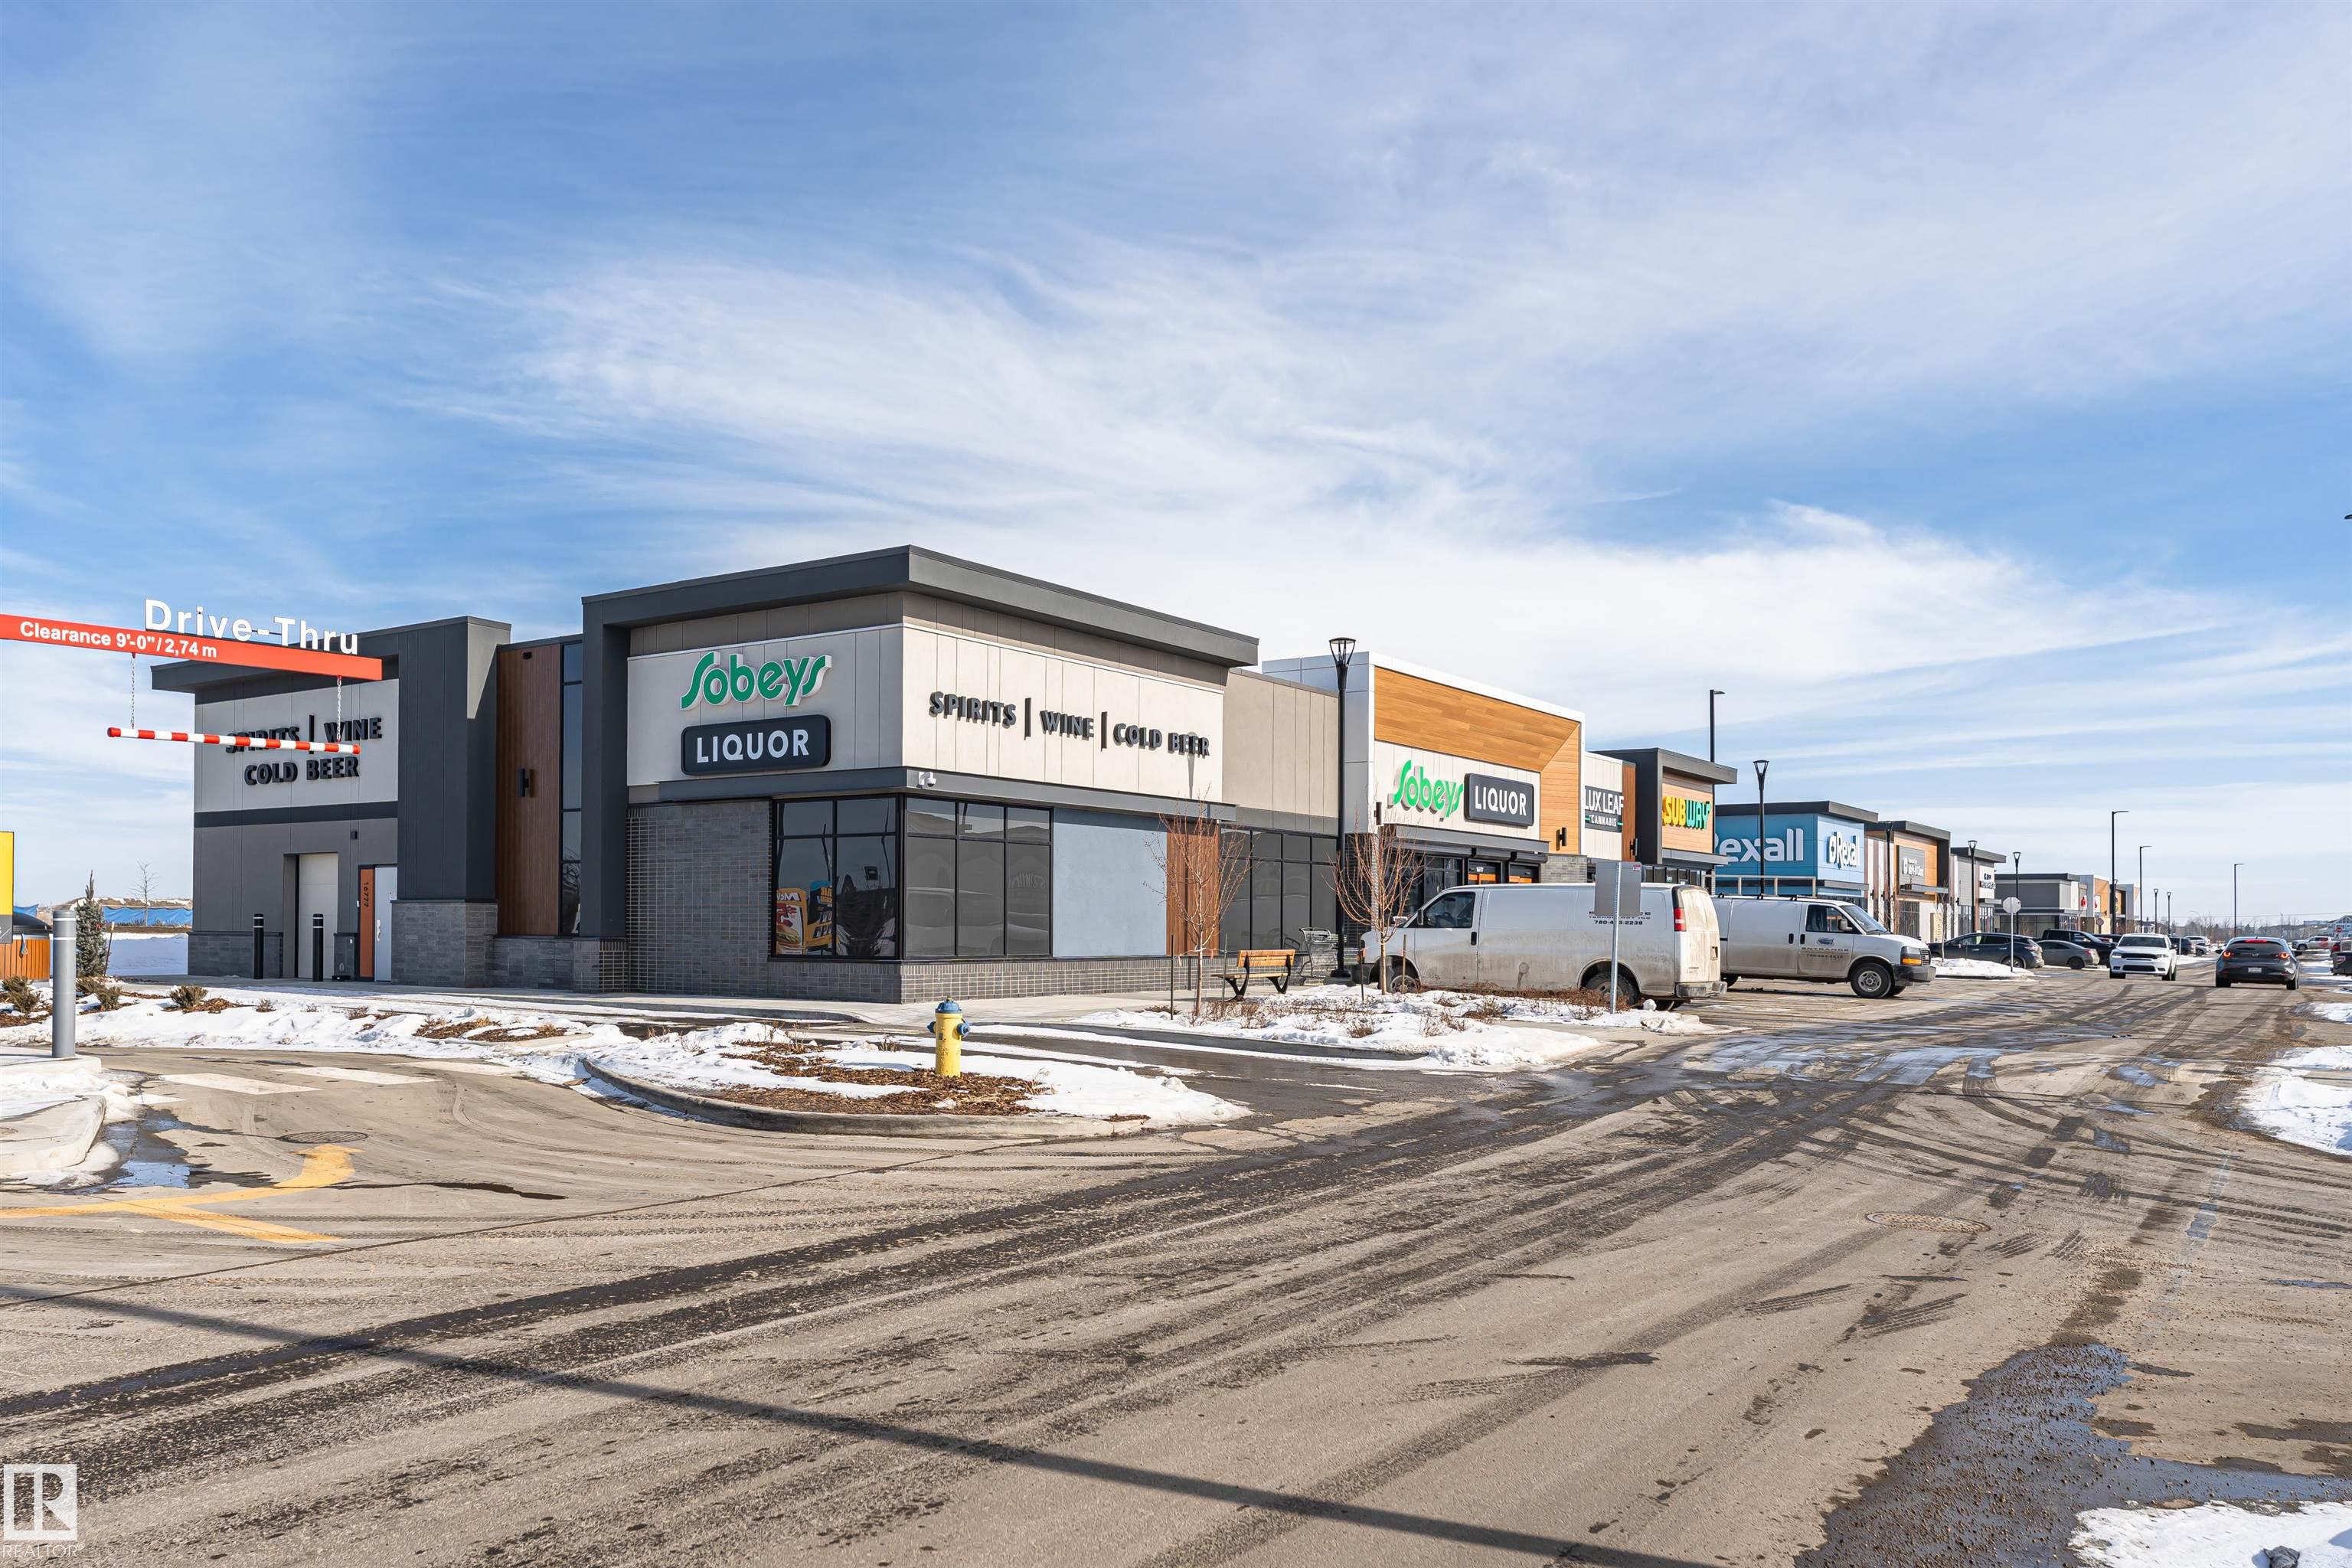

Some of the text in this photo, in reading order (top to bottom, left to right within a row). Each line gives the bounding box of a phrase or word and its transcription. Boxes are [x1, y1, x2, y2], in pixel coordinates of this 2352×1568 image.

[20, 621, 112, 645] Clearance
[145, 599, 358, 655] Drive-Thru
[680, 651, 831, 710] Sobeys
[324, 717, 382, 743] WINE
[929, 691, 1210, 758] SPIRITS WINE COLD BEER
[697, 729, 809, 763] LIQUOR
[244, 756, 360, 786] COLD BEER
[1391, 760, 1527, 818] Sobeys LIQUOR
[1584, 788, 1624, 815] LUX LEAF
[1589, 815, 1617, 827] CANNABIS
[1662, 796, 1710, 830] SUBWAY
